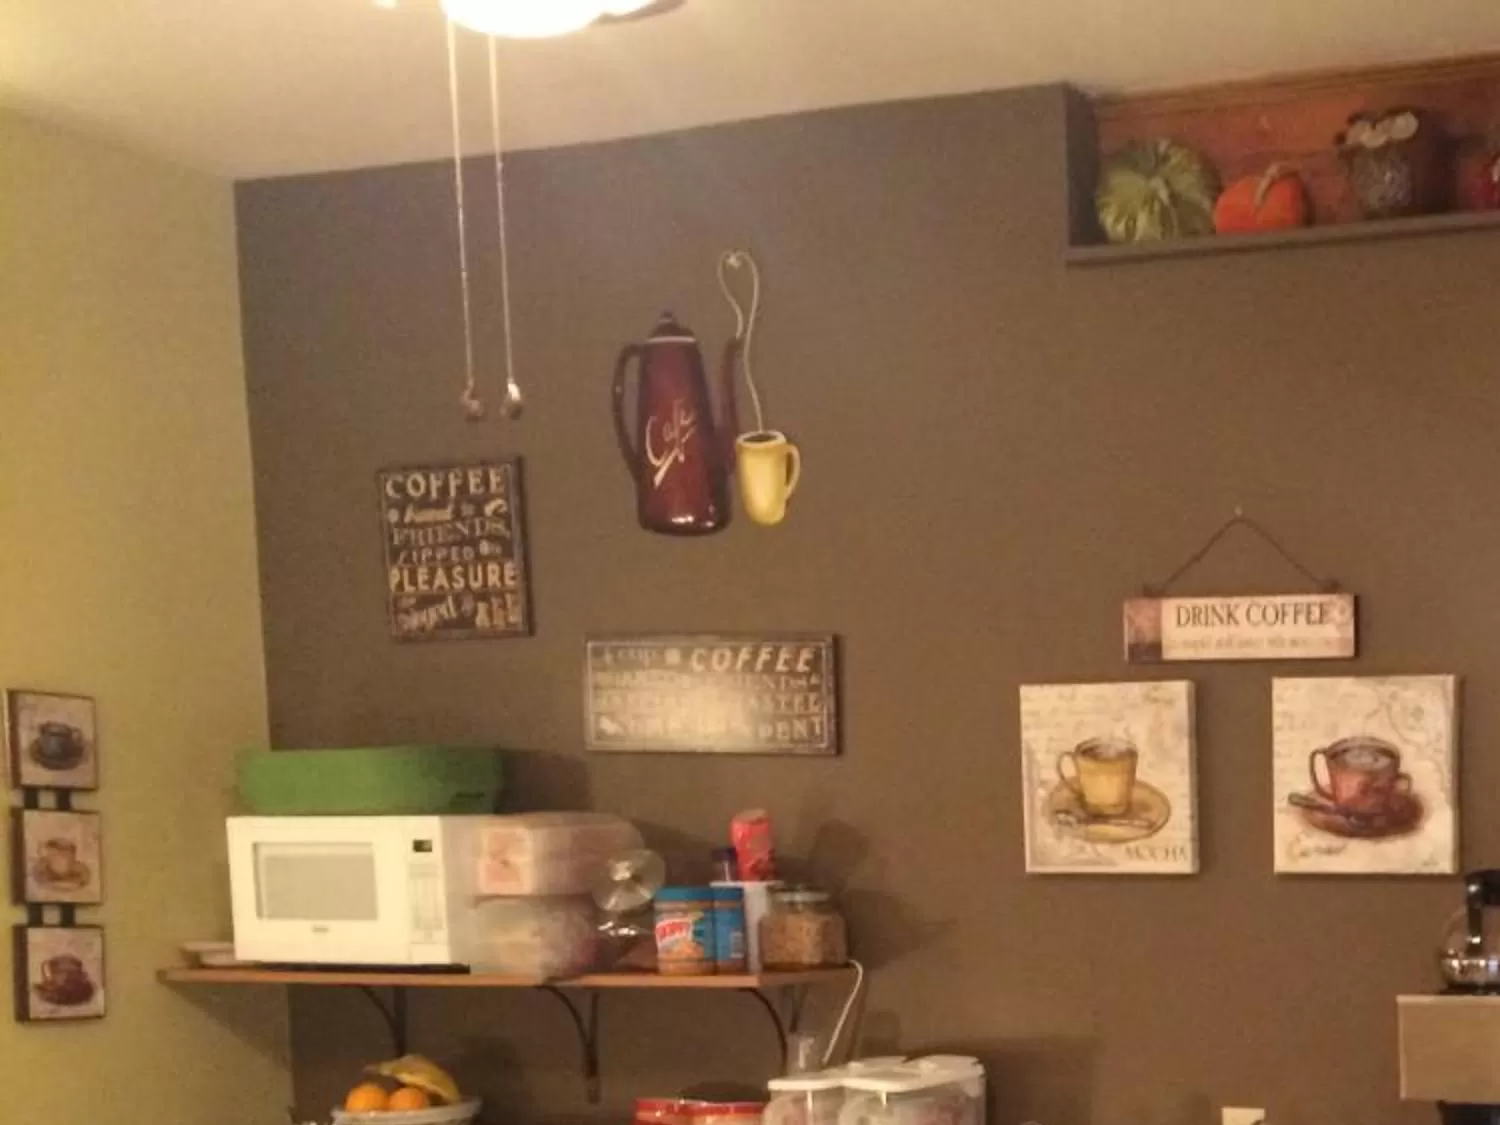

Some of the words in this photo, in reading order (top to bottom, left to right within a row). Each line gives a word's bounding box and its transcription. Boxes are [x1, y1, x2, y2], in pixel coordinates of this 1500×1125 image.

[385, 467, 507, 500] COFFEE
[388, 560, 520, 593] PLEASURE
[1176, 603, 1240, 628] DRINK
[1245, 600, 1329, 626] COFFEE
[690, 646, 816, 673] COFFEE
